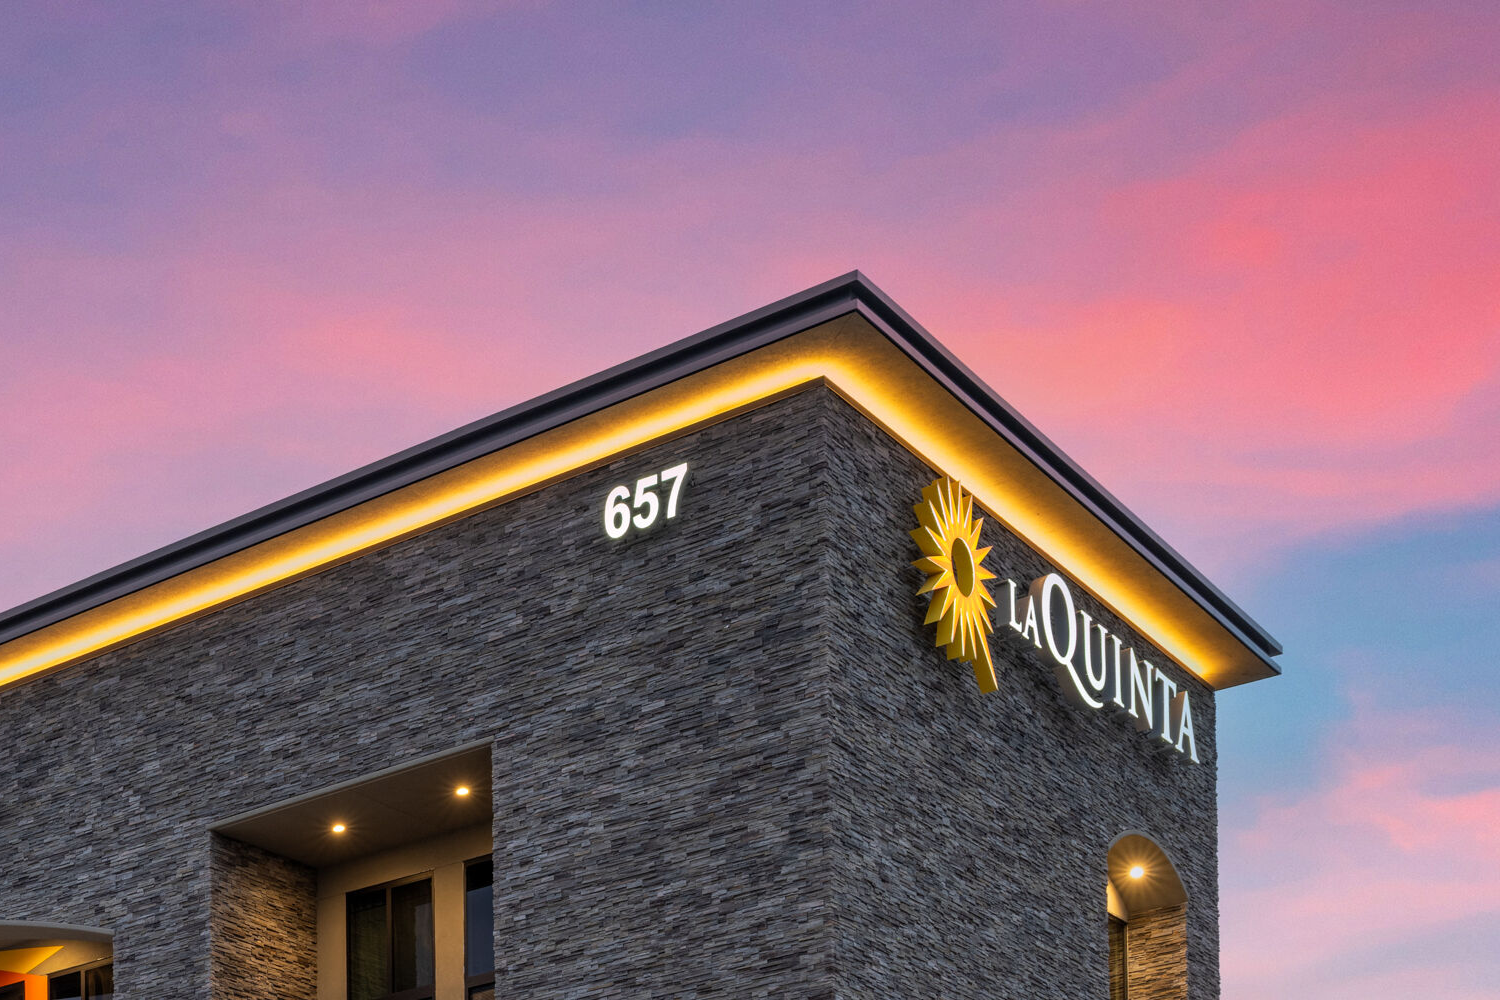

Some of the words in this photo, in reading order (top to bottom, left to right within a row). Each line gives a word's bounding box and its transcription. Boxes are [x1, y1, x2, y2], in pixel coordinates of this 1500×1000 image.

[604, 462, 688, 539] 657
[1007, 578, 1042, 649] LA
[1041, 572, 1200, 764] QUINTA
